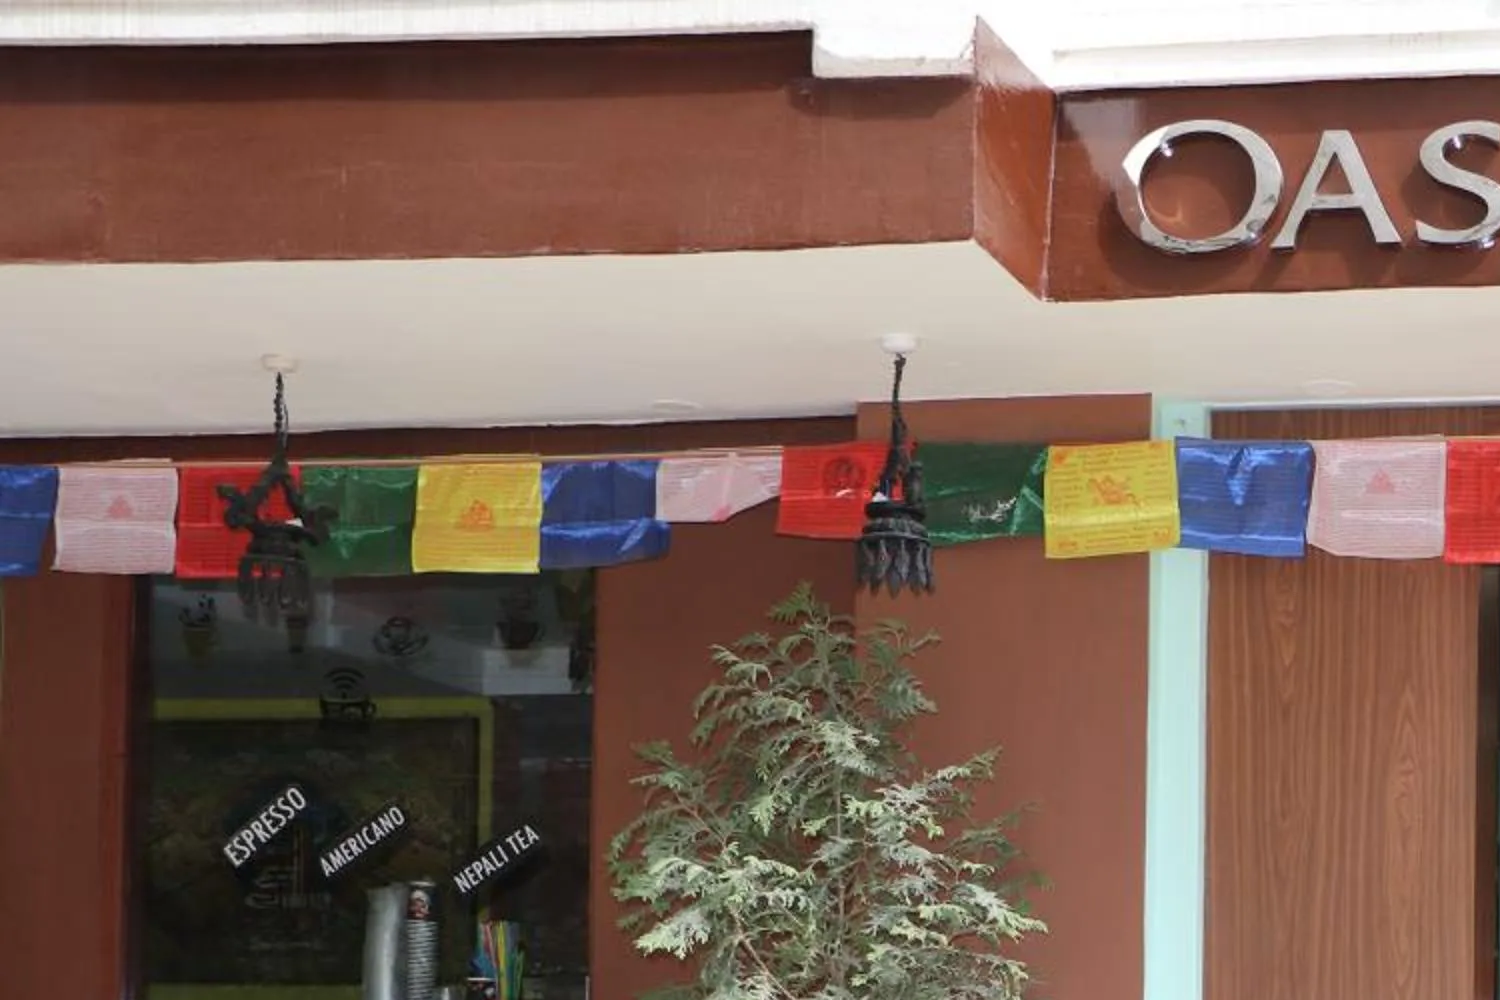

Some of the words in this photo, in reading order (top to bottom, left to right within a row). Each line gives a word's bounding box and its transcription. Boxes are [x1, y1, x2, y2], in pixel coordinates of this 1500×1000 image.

[223, 787, 307, 868] ESPRESSO
[319, 806, 406, 877] AMERICANO
[453, 845, 509, 893] NEPALI
[505, 824, 540, 855] TEA
